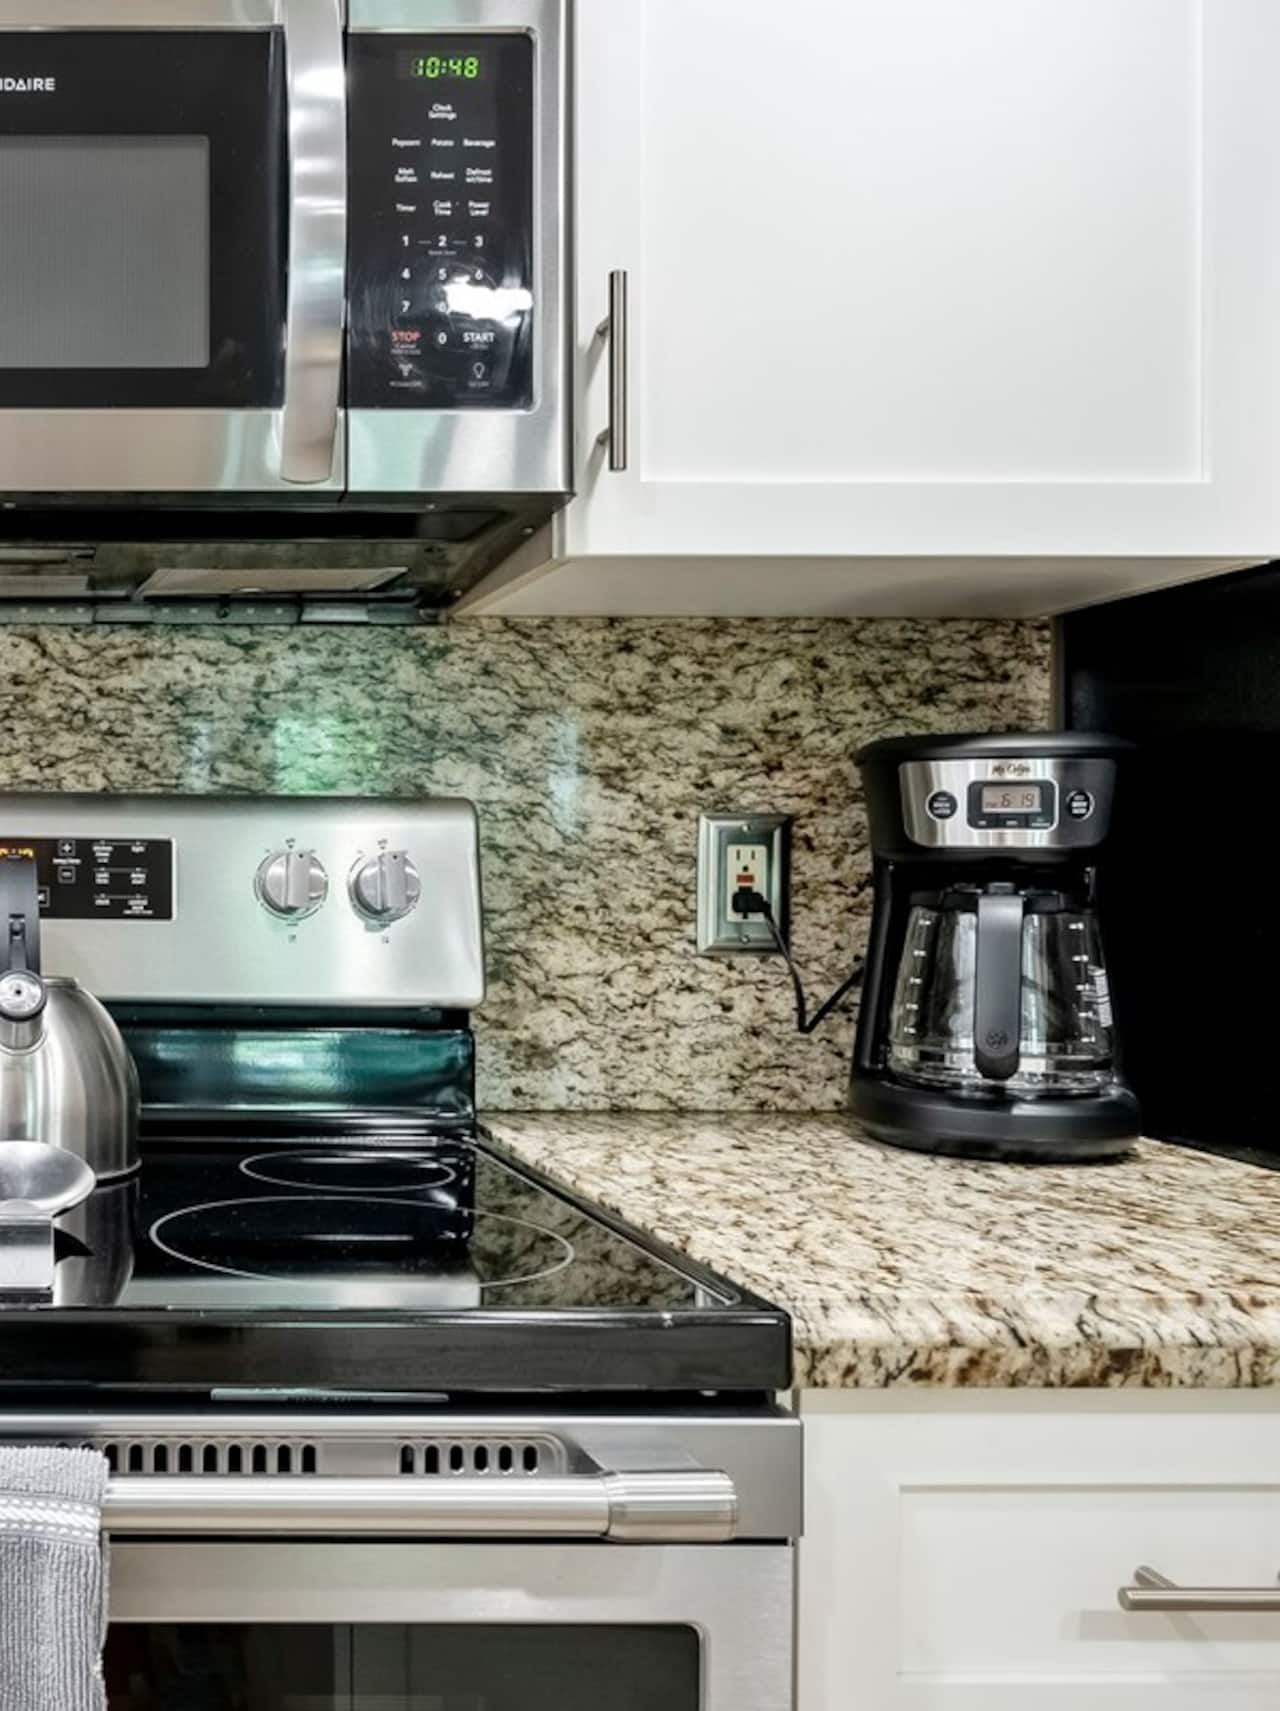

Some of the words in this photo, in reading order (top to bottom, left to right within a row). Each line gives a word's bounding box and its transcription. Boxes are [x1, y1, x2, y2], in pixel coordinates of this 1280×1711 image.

[417, 56, 479, 78] 10:48
[402, 235, 409, 247] 1
[438, 235, 447, 247] 2
[475, 235, 483, 248] 3
[401, 267, 411, 279] 4
[438, 267, 447, 280] 5
[475, 268, 483, 280] 6
[401, 300, 410, 313] 7
[391, 330, 421, 342] STOP
[438, 331, 447, 344] 0
[463, 332, 495, 343] START
